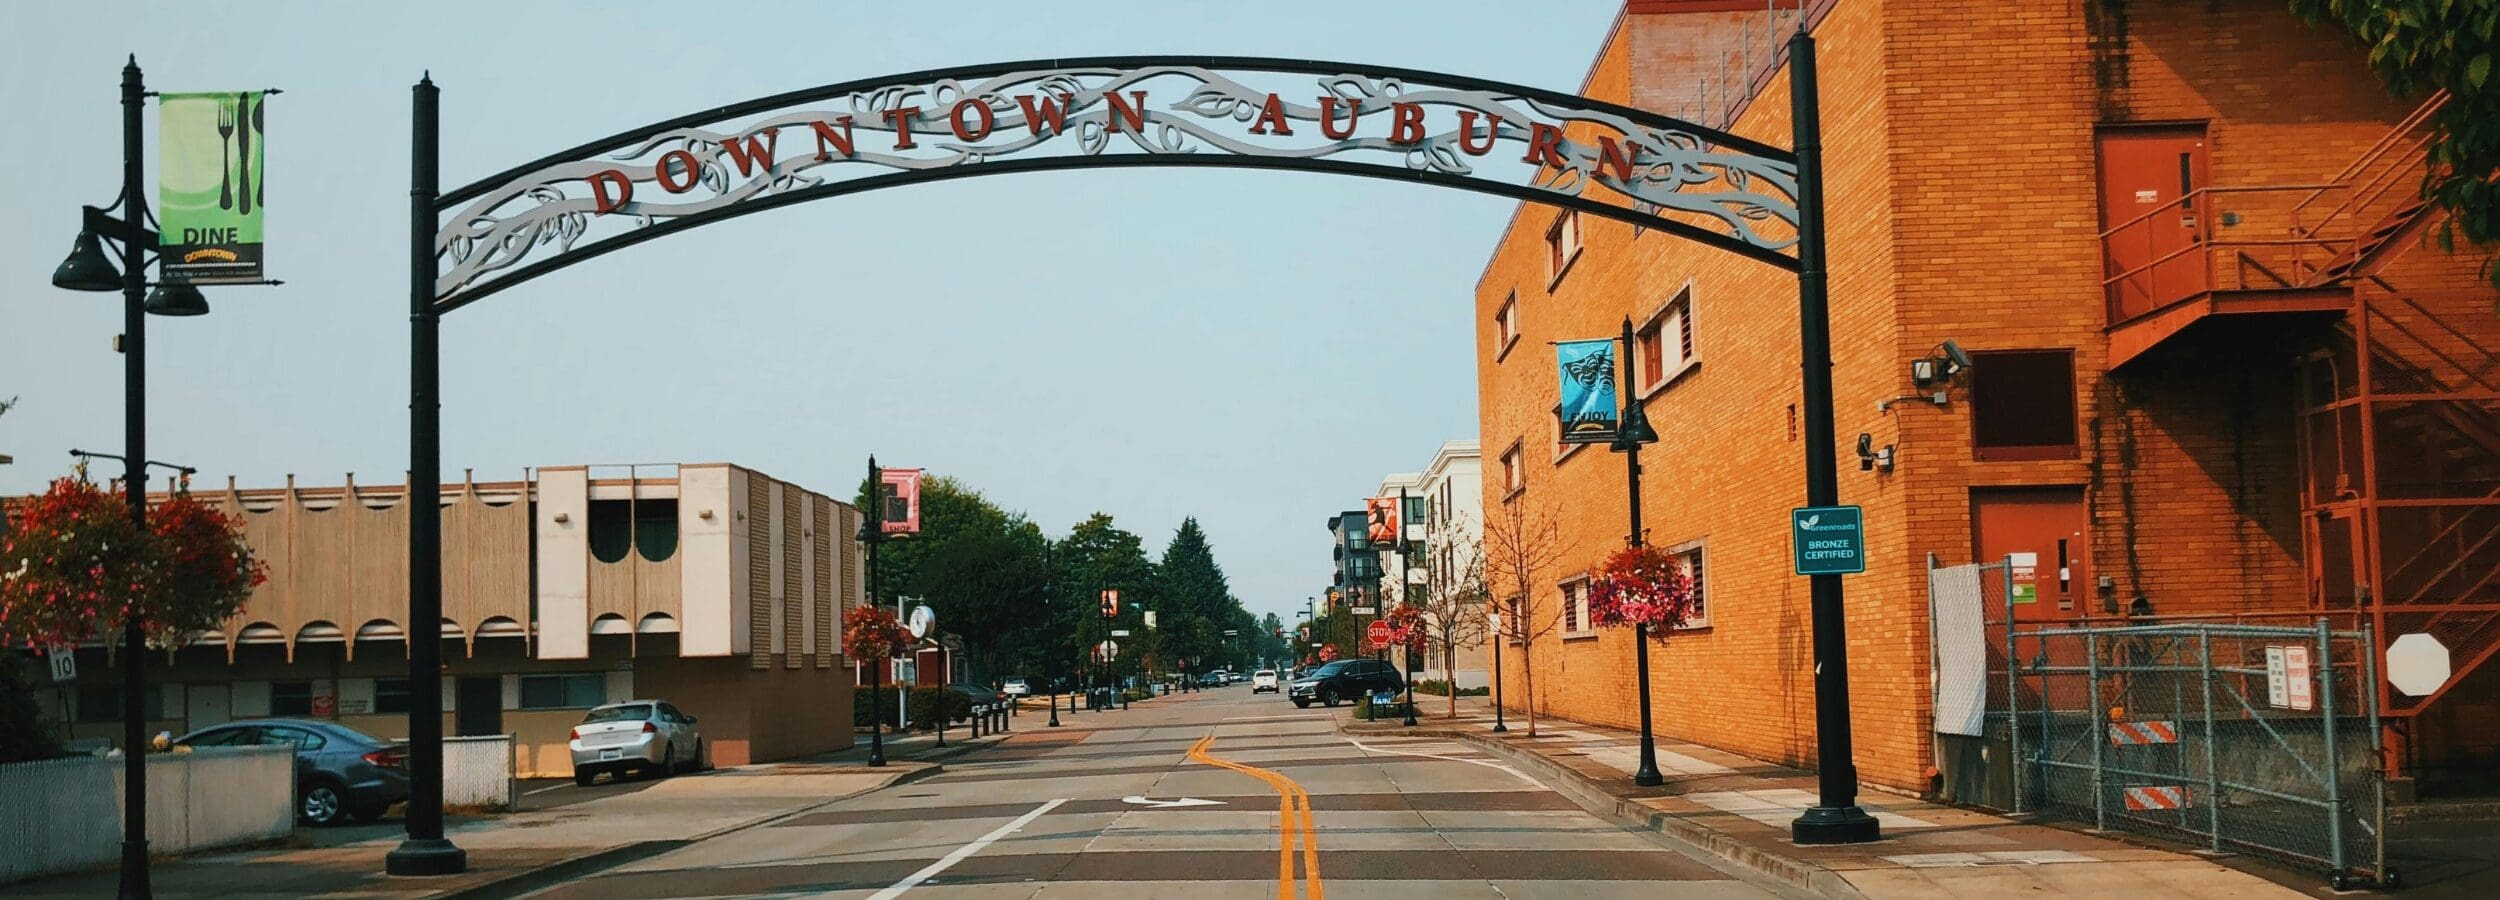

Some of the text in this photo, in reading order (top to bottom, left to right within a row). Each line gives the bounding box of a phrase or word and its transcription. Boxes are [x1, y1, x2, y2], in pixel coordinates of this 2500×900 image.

[585, 90, 1643, 216] DOWNTOWN AUBURN
[183, 227, 238, 245] DINE
[184, 248, 238, 263] DOWNTOWN
[1571, 411, 1609, 422] ENJOY
[888, 525, 912, 533] SHOP
[1810, 523, 1856, 531] Greenroads
[1808, 540, 1850, 549] BRONZE
[1804, 549, 1855, 560] CERTIFIED
[56, 656, 73, 677] 10
